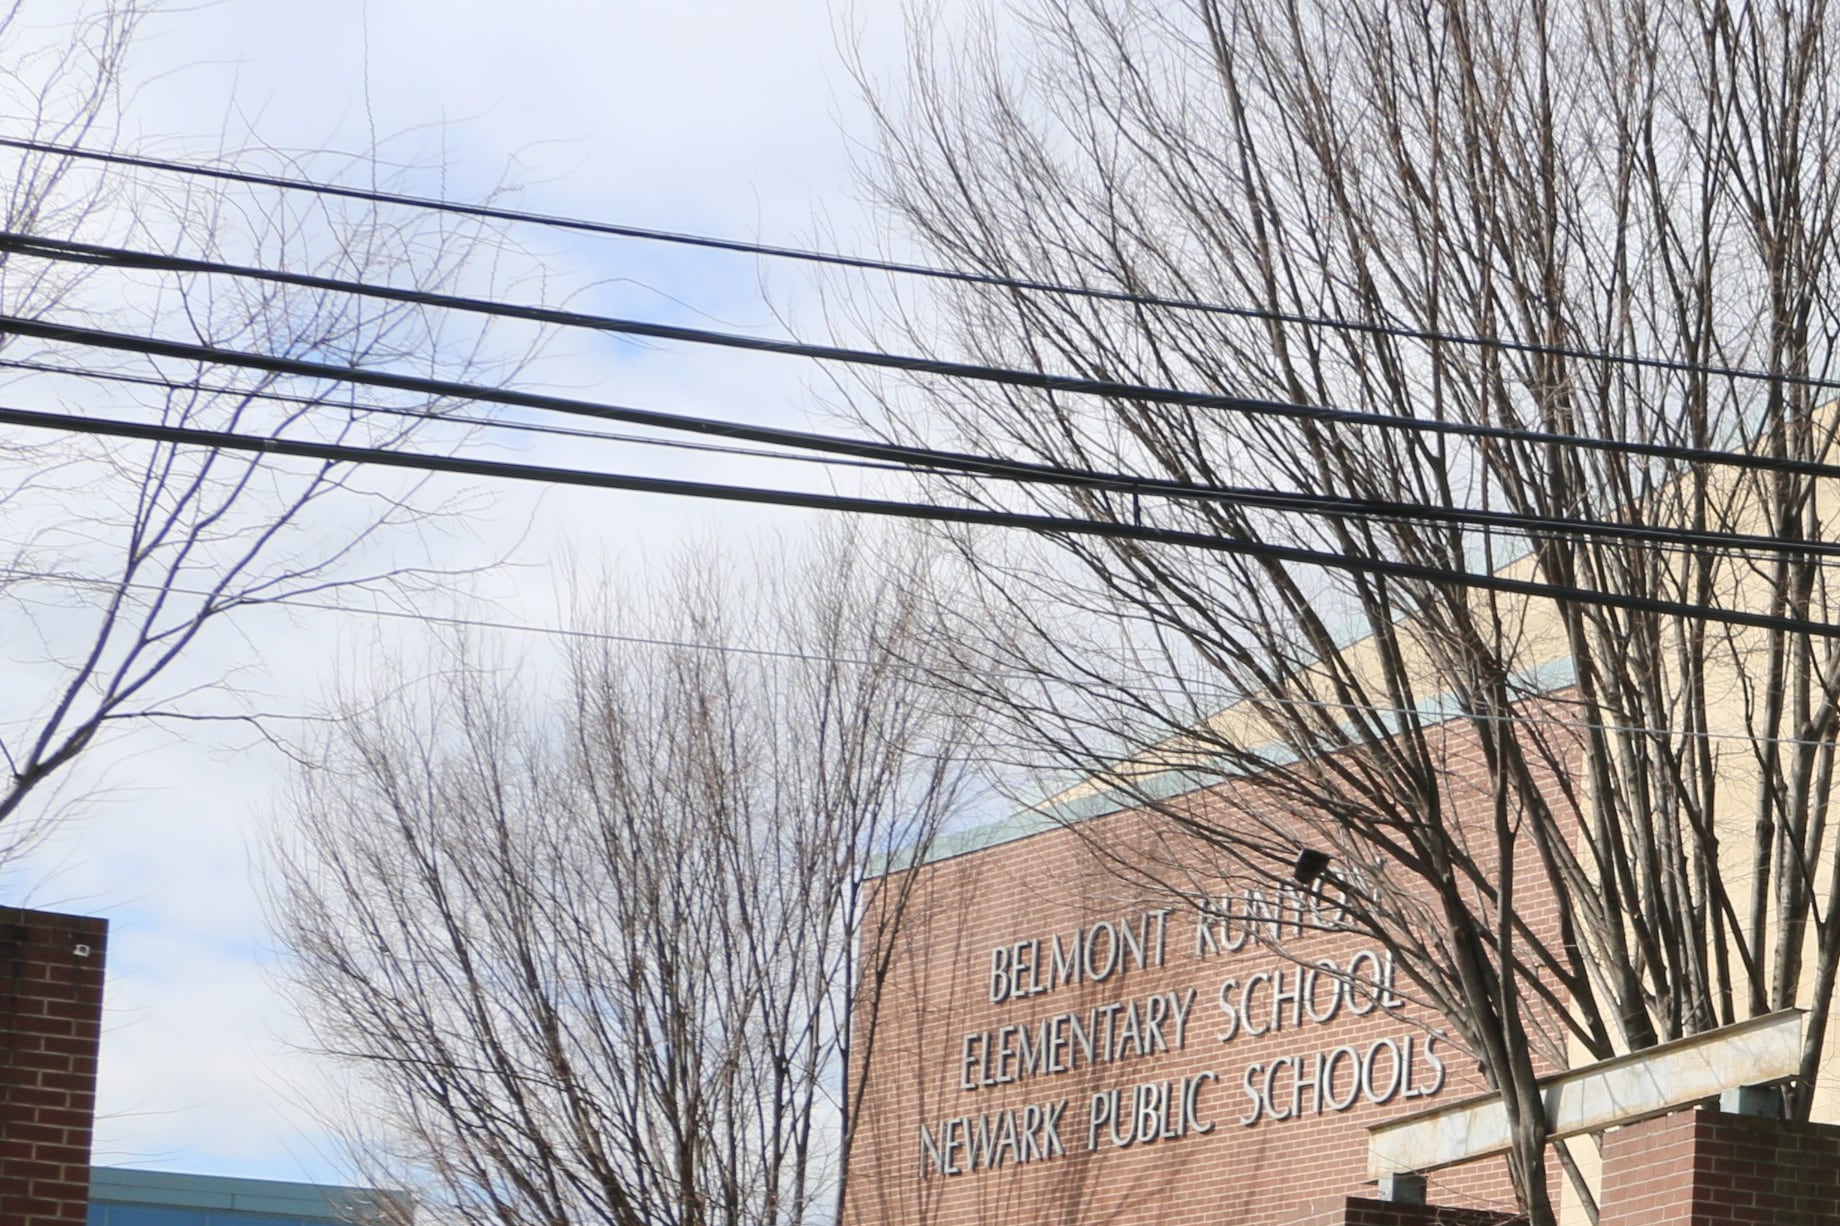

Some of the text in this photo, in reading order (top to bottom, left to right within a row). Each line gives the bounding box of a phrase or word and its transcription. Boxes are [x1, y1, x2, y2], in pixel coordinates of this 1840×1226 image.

[989, 858, 1382, 1004] BELMONT RUNYO
[960, 949, 1405, 1091] ELEMENTARY SCHOOL
[919, 1029, 1446, 1179] NEWARK PUBLIC SCHOOLS
